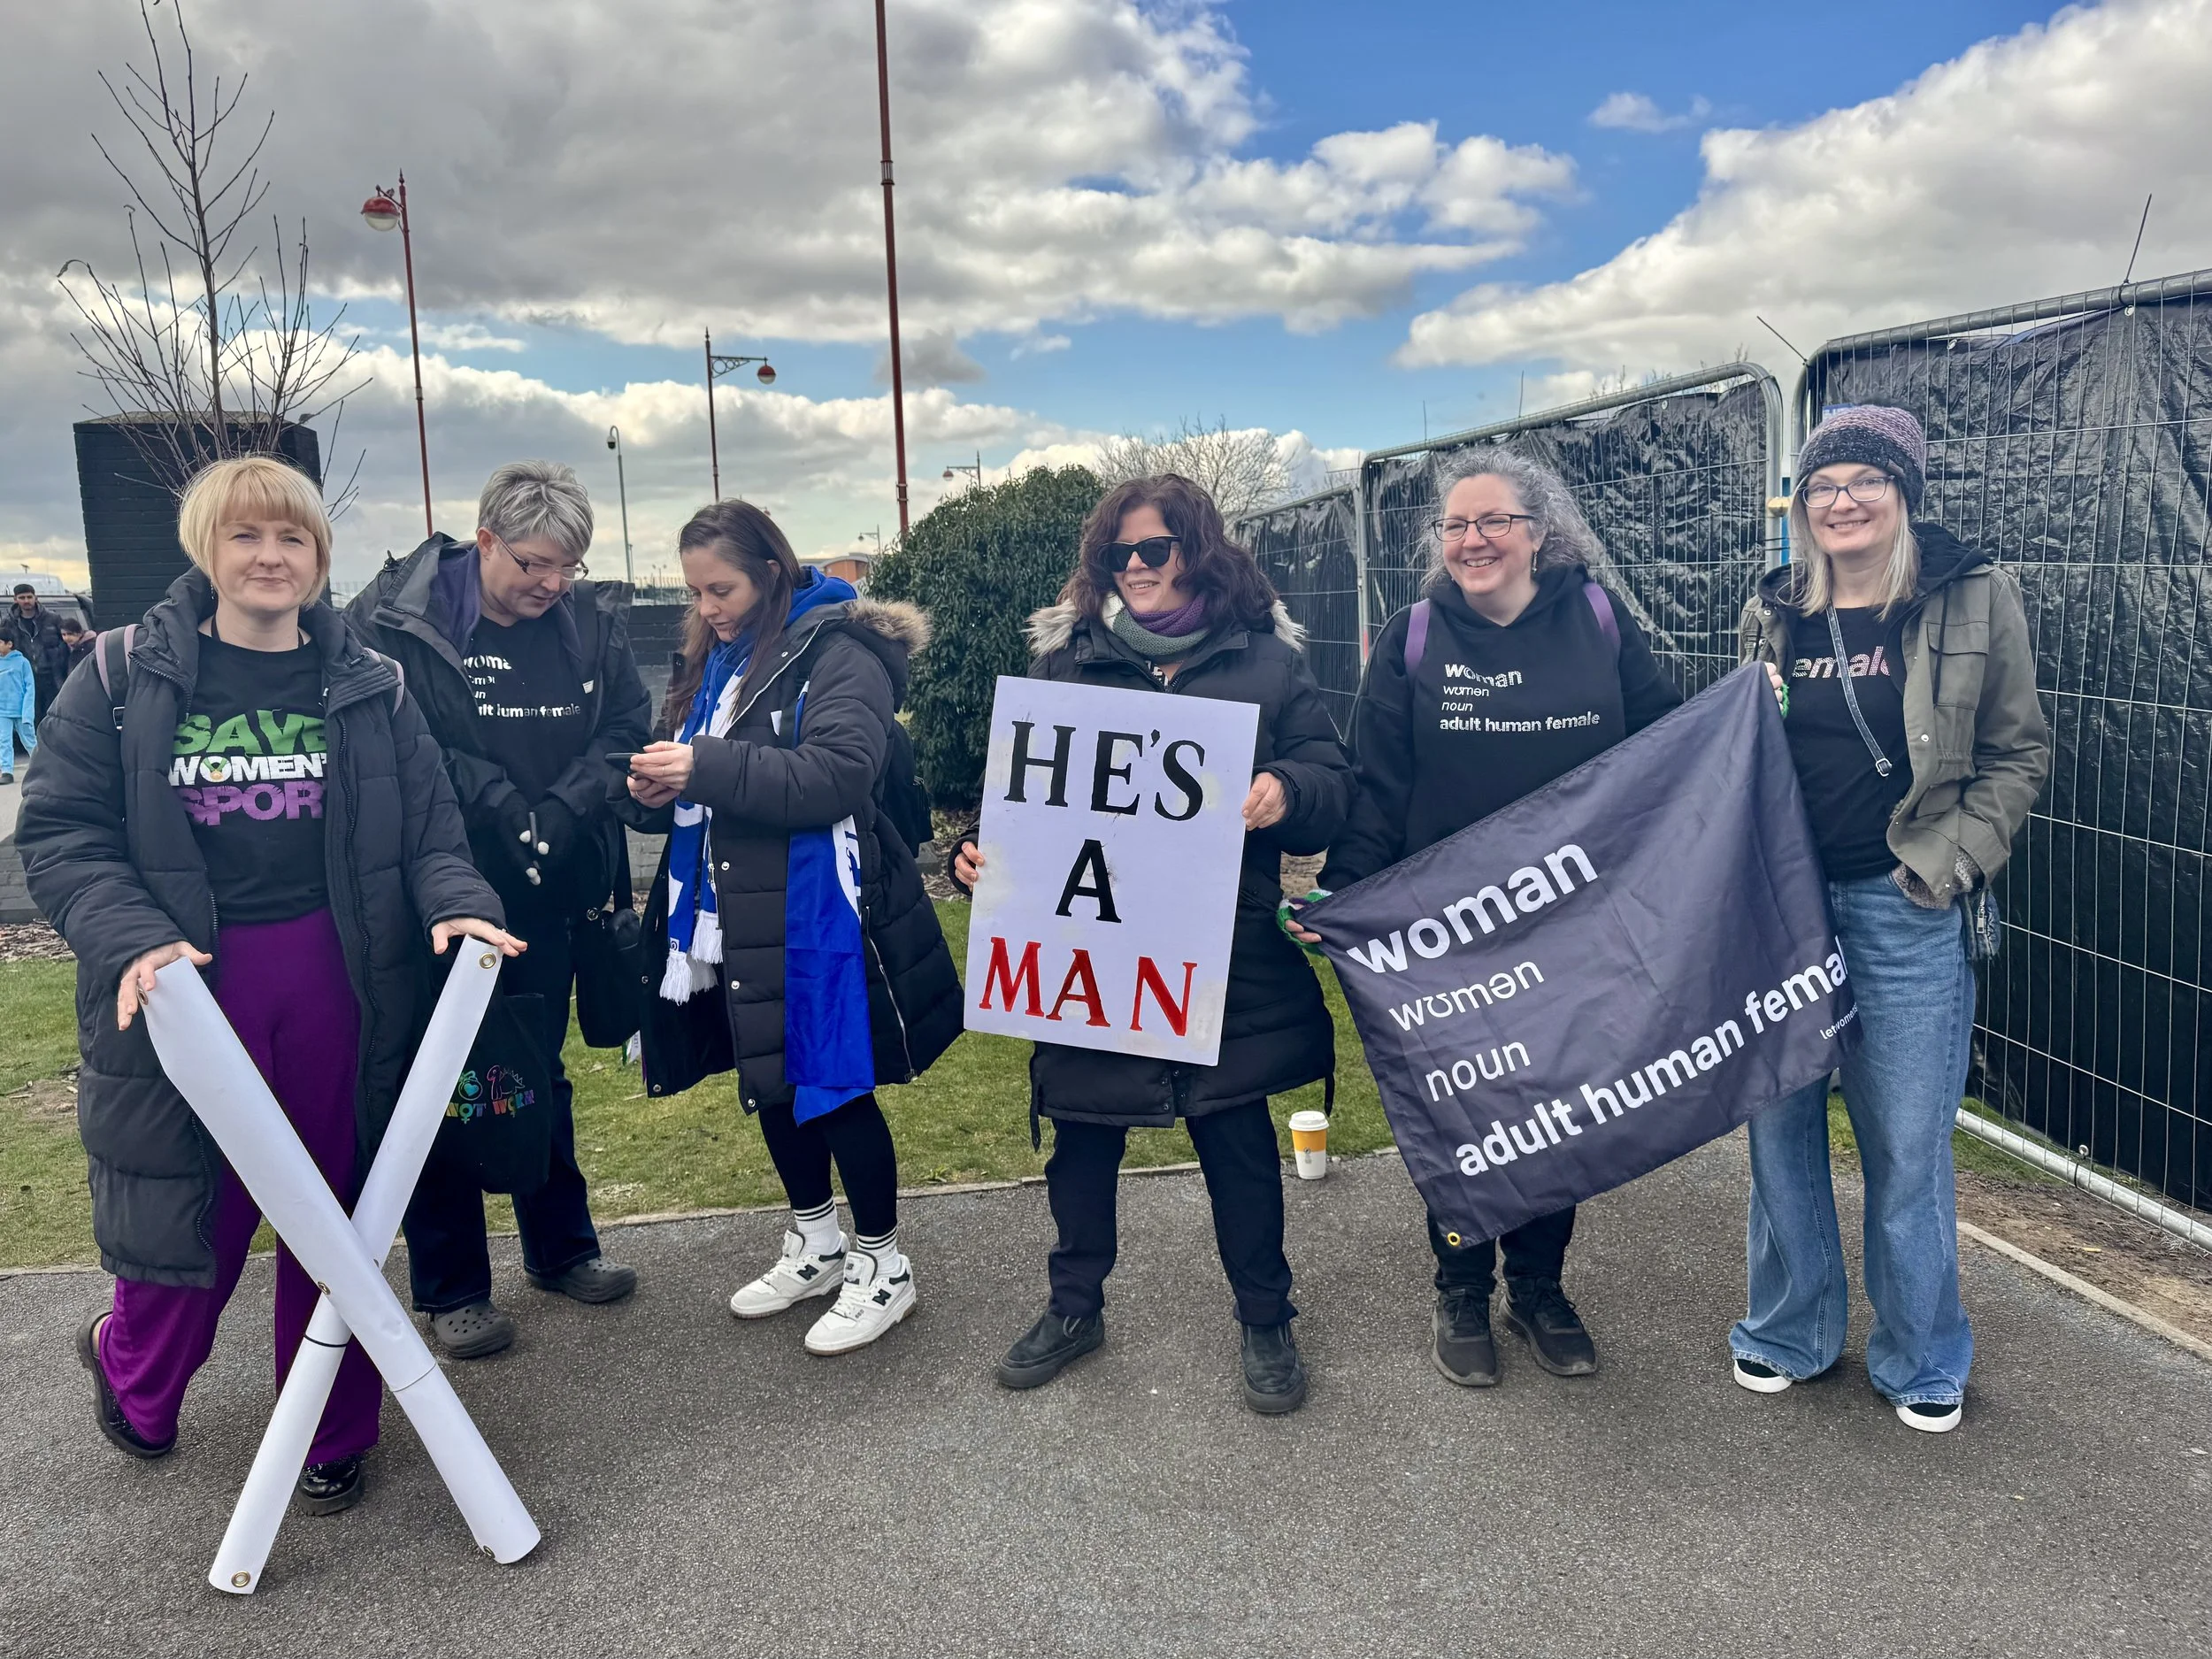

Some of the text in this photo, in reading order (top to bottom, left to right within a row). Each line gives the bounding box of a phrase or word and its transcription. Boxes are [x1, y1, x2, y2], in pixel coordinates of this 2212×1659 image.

[1441, 702, 1473, 711] noun
[1445, 664, 1523, 688] woman
[1440, 710, 1600, 732] adult human female
[179, 780, 326, 826] SPOR
[1003, 720, 1206, 822] HE'S
[1056, 839, 1122, 924] A
[1346, 844, 1598, 973] woman
[979, 936, 1198, 1037] MAN
[1425, 1040, 1532, 1102] noun
[1455, 1098, 1583, 1177] adult
[1579, 1018, 1745, 1125] human
